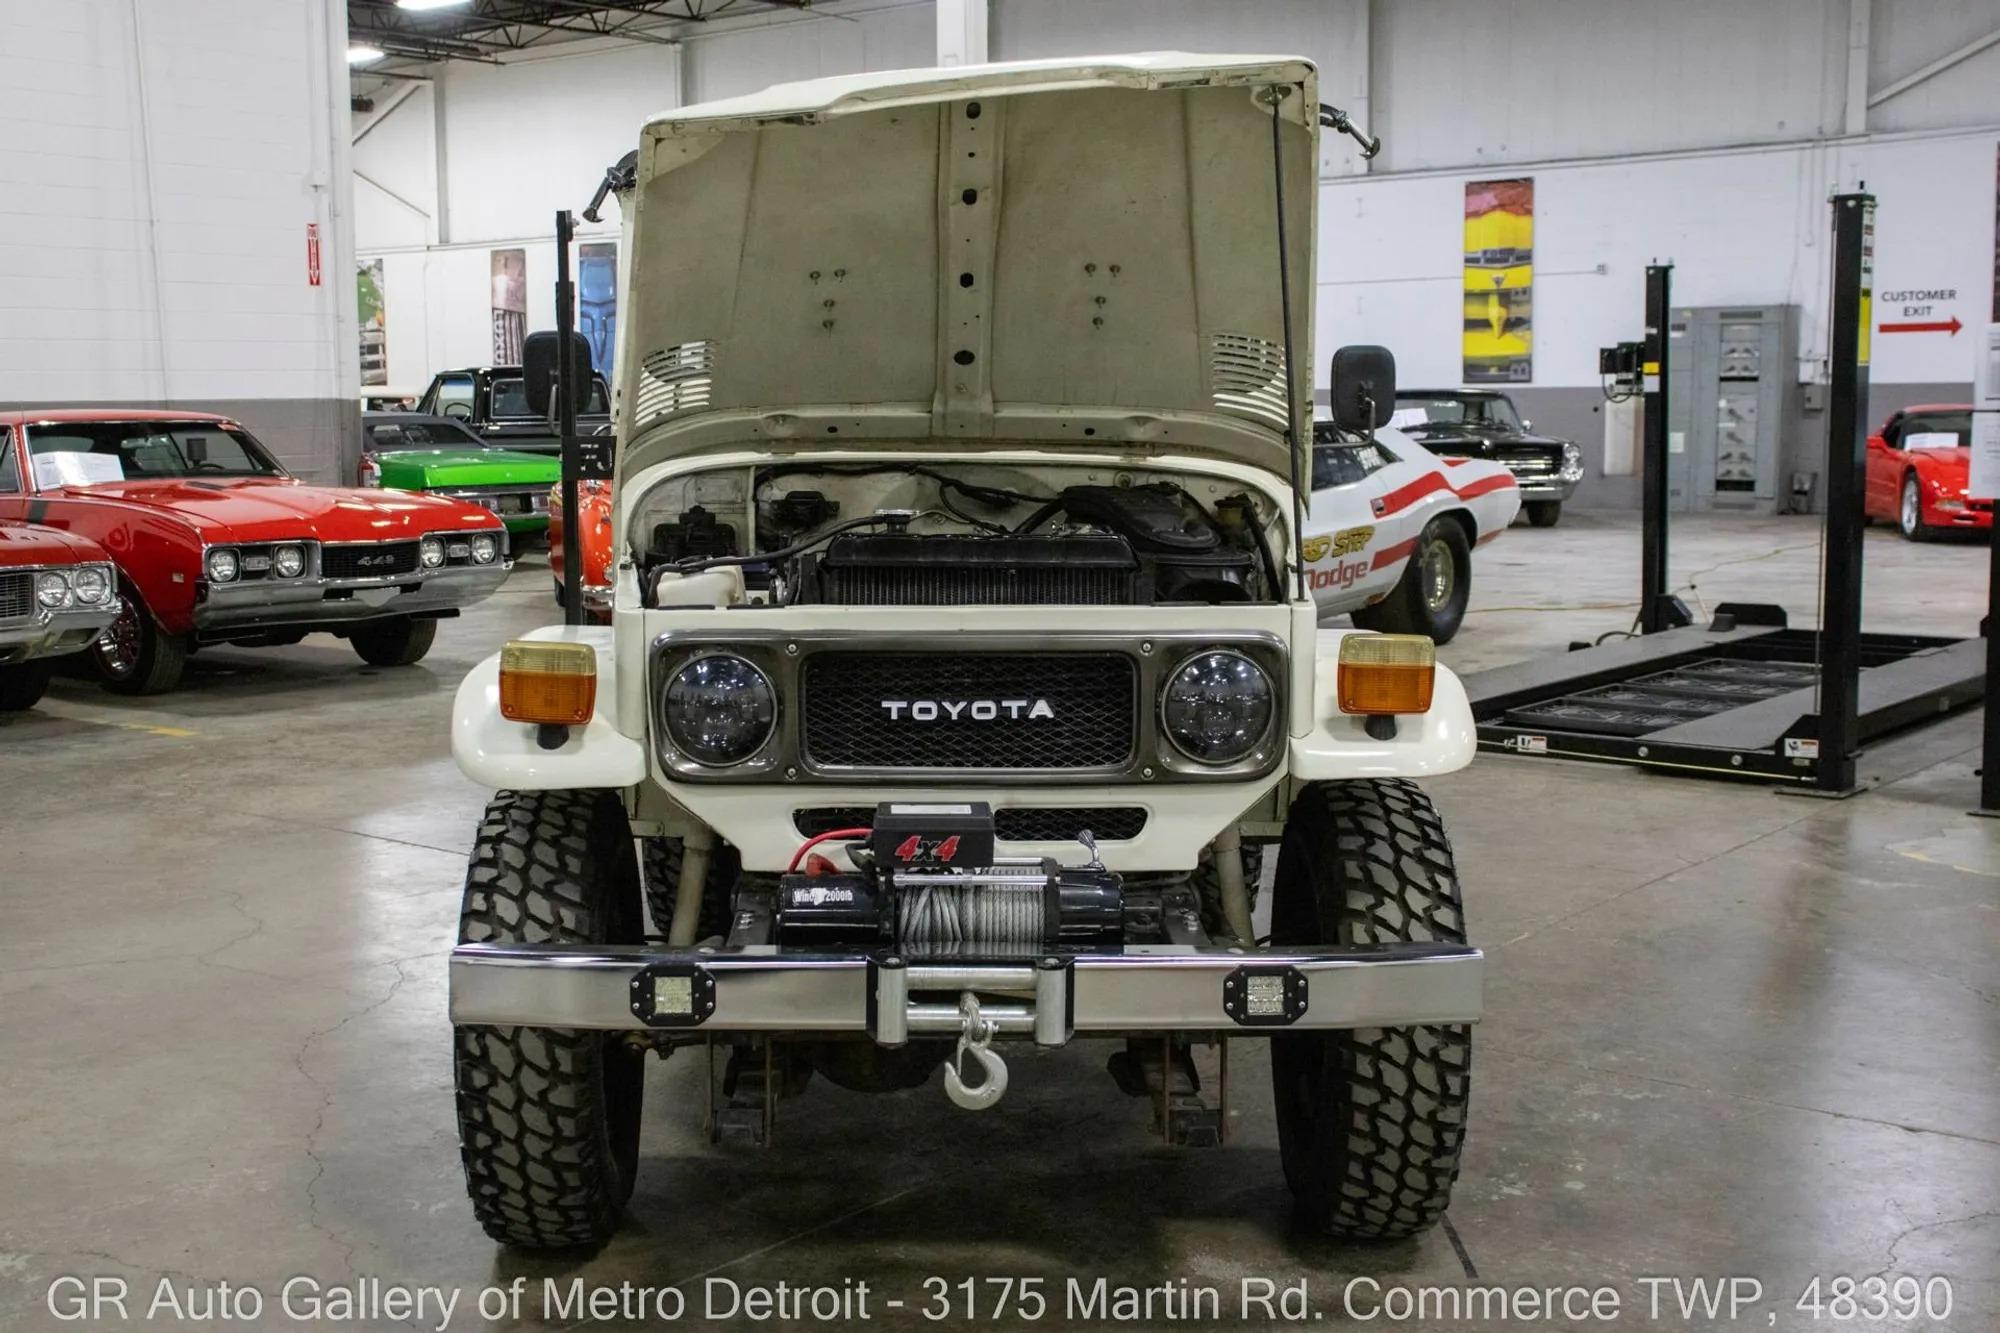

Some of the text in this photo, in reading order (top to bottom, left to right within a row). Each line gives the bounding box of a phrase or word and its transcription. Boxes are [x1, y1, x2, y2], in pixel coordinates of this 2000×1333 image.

[1881, 289, 1957, 302] CUSTOMER
[1903, 305, 1932, 317] EXIT
[881, 699, 1055, 720] TOYOTA
